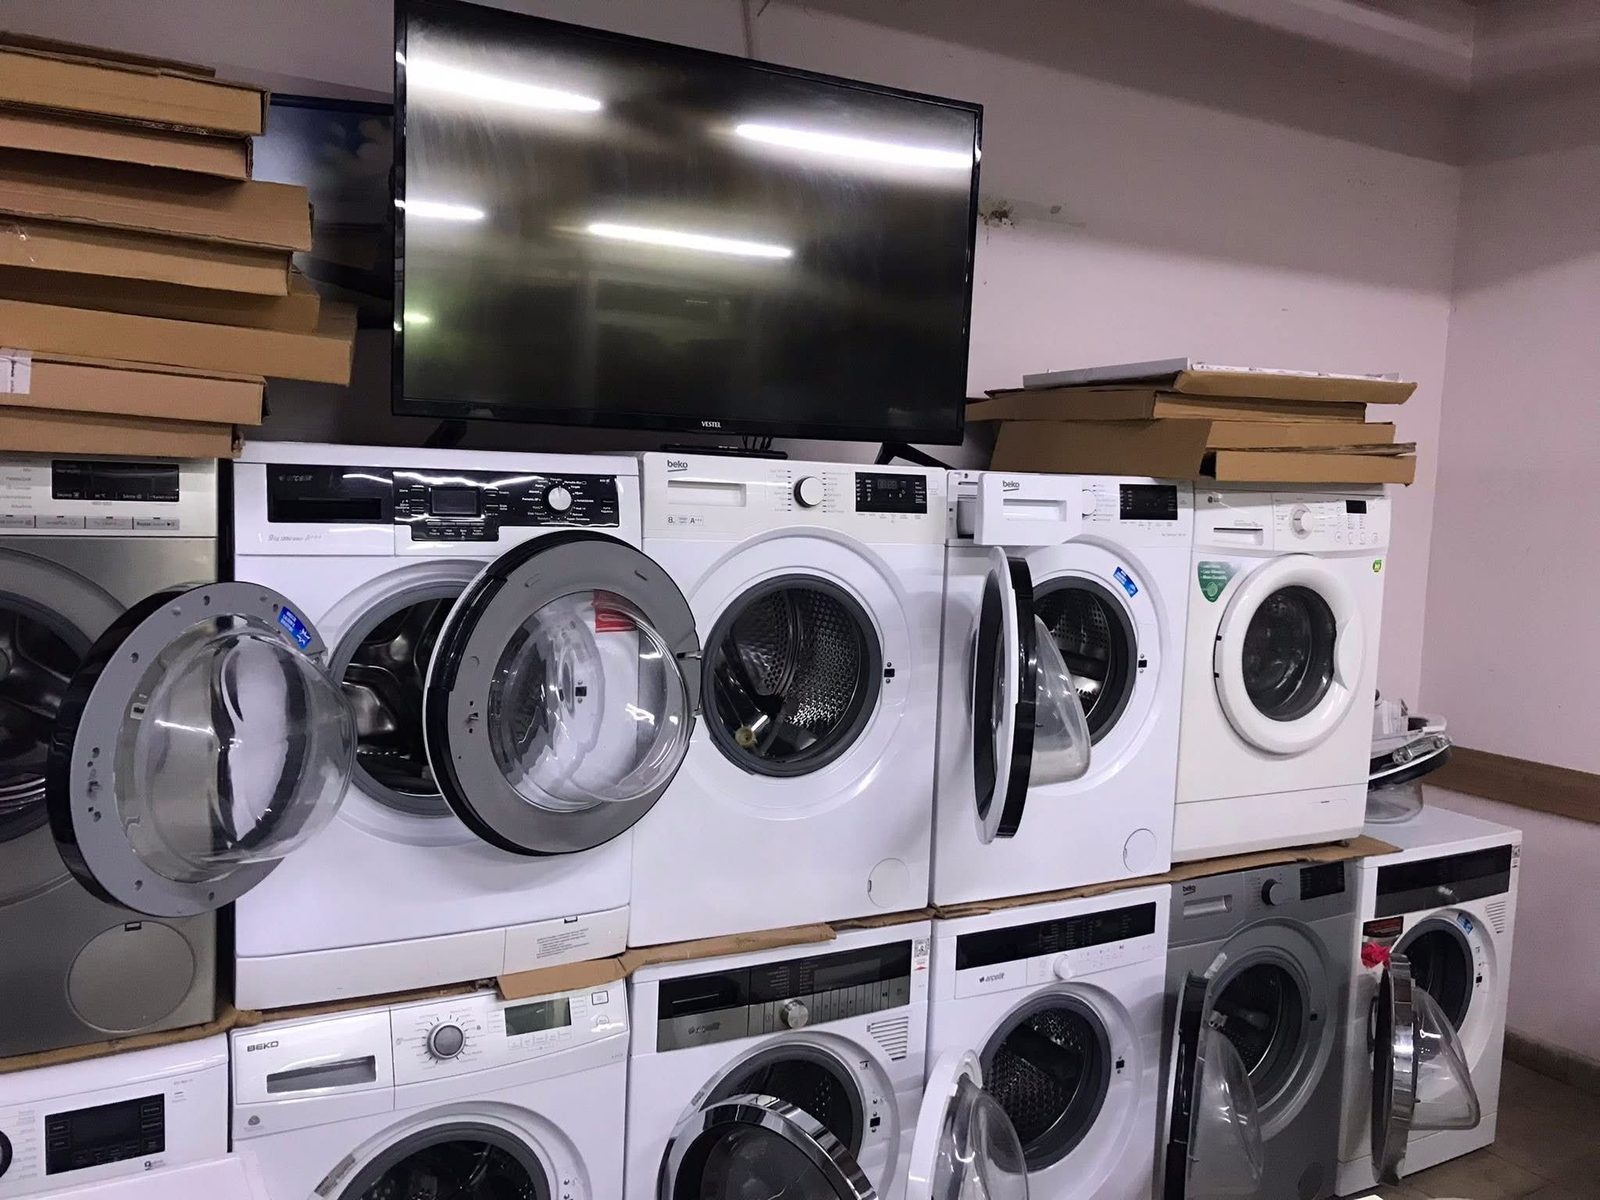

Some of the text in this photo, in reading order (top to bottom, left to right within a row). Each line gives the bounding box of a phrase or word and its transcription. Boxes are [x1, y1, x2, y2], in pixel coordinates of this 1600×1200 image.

[667, 460, 688, 469] beko
[1002, 480, 1020, 488] beko
[247, 1041, 279, 1052] BEKO
